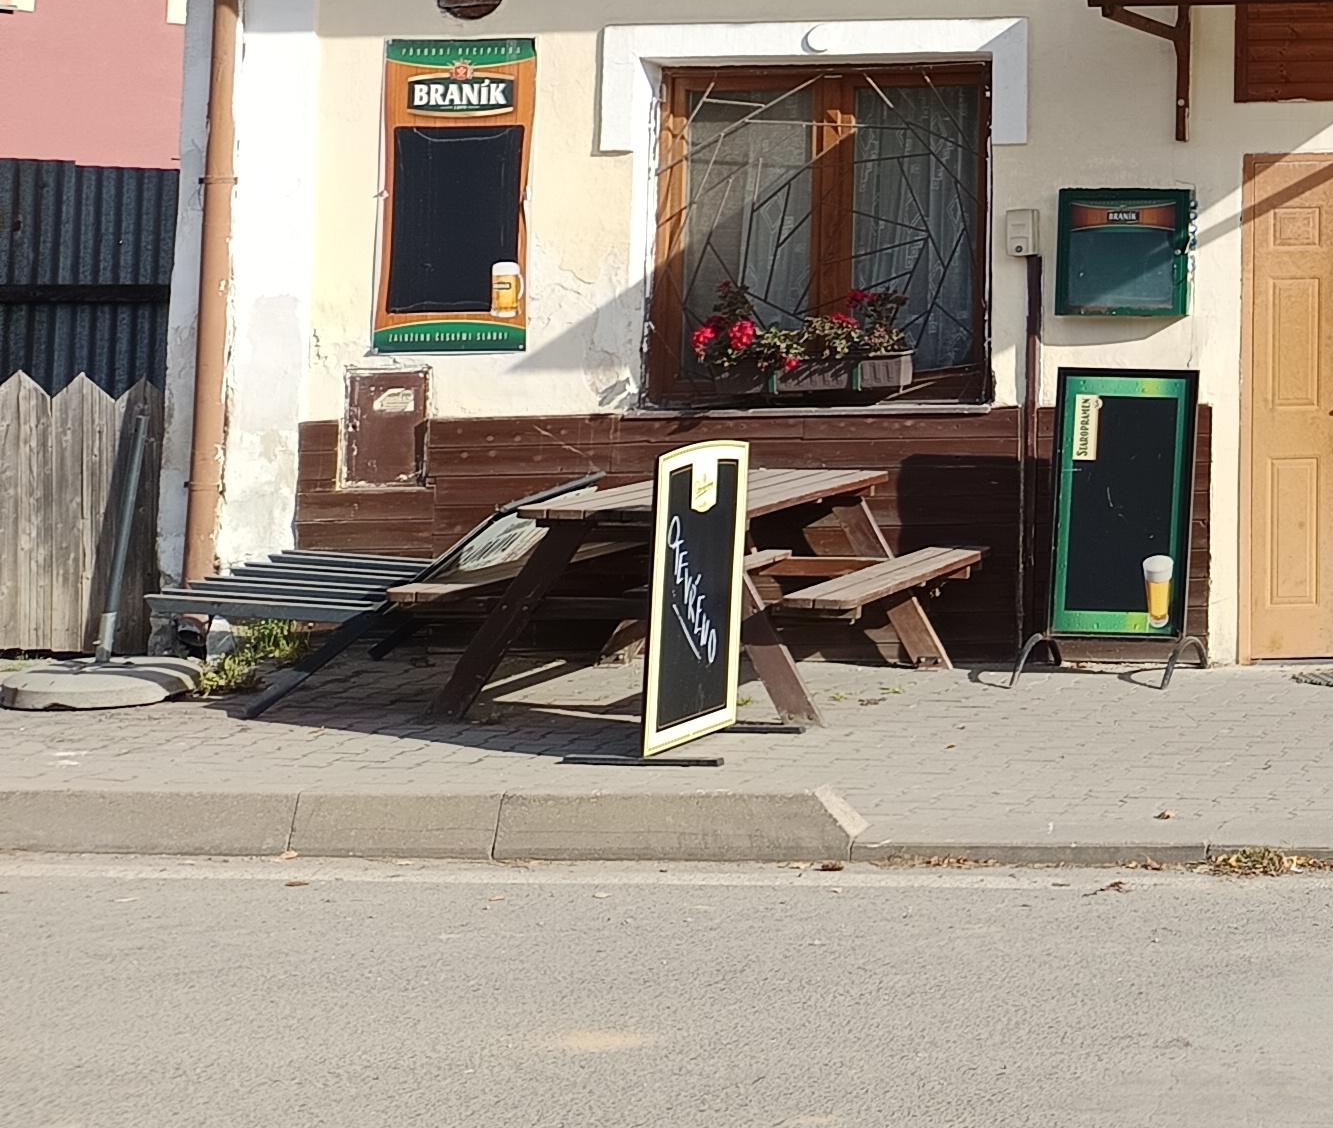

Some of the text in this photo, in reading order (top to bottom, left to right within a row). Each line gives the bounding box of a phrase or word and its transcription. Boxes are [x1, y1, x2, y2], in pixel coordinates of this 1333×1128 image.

[413, 79, 507, 106] BRANÍK
[1076, 397, 1091, 457] STAROPRAMEN
[666, 514, 717, 664] OTEVŘENO
